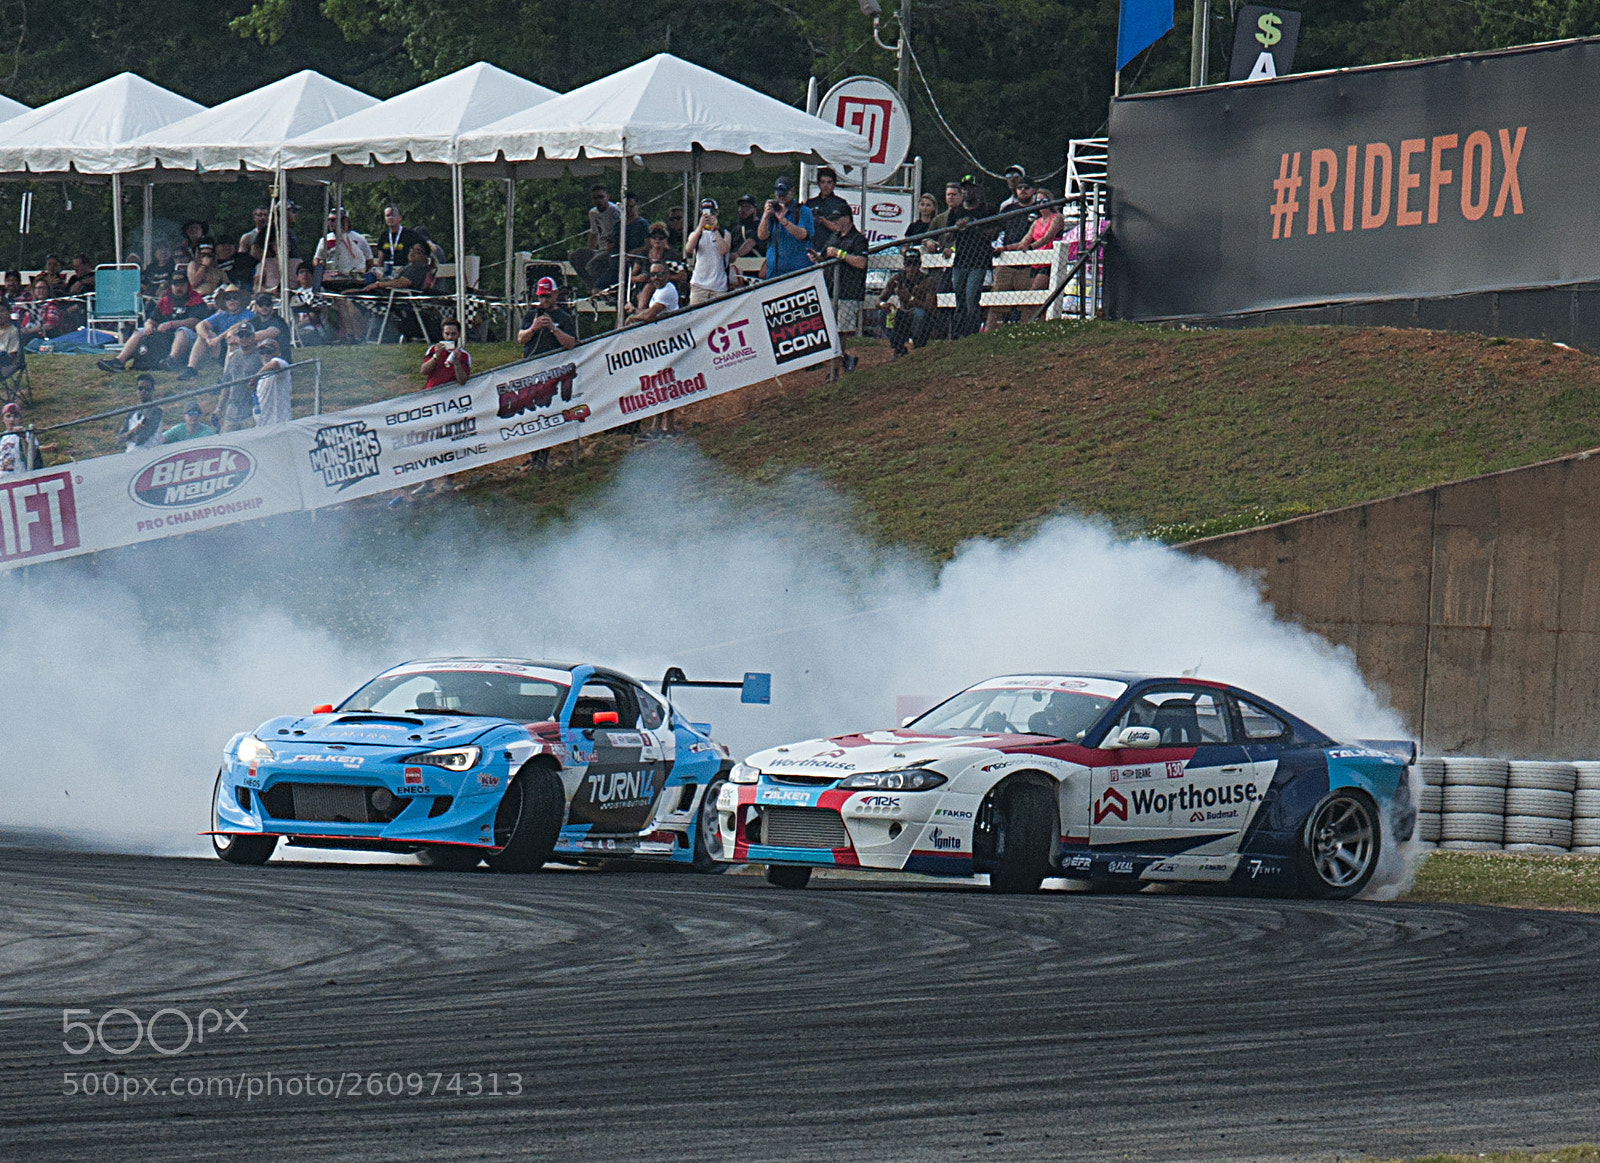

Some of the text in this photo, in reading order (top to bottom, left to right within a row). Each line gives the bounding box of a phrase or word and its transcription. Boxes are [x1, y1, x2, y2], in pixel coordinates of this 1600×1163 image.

[1269, 126, 1527, 239] #RIDEFOX
[764, 289, 818, 317] MOTOR
[767, 304, 820, 328] WORLD
[707, 318, 749, 354] GT
[771, 317, 824, 343] HYPE
[775, 330, 827, 358] .COM
[497, 362, 577, 395] EVERYTHING
[638, 367, 676, 392] Drift
[618, 372, 707, 415] Illustrated
[385, 394, 472, 426] BOOSTIAD
[500, 403, 591, 441] MotoIQ
[310, 430, 380, 471] MONSTERS
[323, 426, 357, 447] WHAT
[149, 449, 239, 488] Black
[324, 456, 379, 486] DO.COM
[163, 474, 236, 506] Magic
[0, 478, 65, 556] IFT
[137, 497, 264, 533] PRO CHAMPIONSHIP
[292, 753, 365, 765] FALKEN
[1167, 763, 1183, 776] 130
[397, 786, 430, 794] ENEOS
[588, 770, 655, 805] TURN14
[762, 790, 811, 801] FALKEN
[866, 796, 900, 806] ARK
[943, 809, 973, 819] FAKRO
[934, 833, 961, 849] ignite
